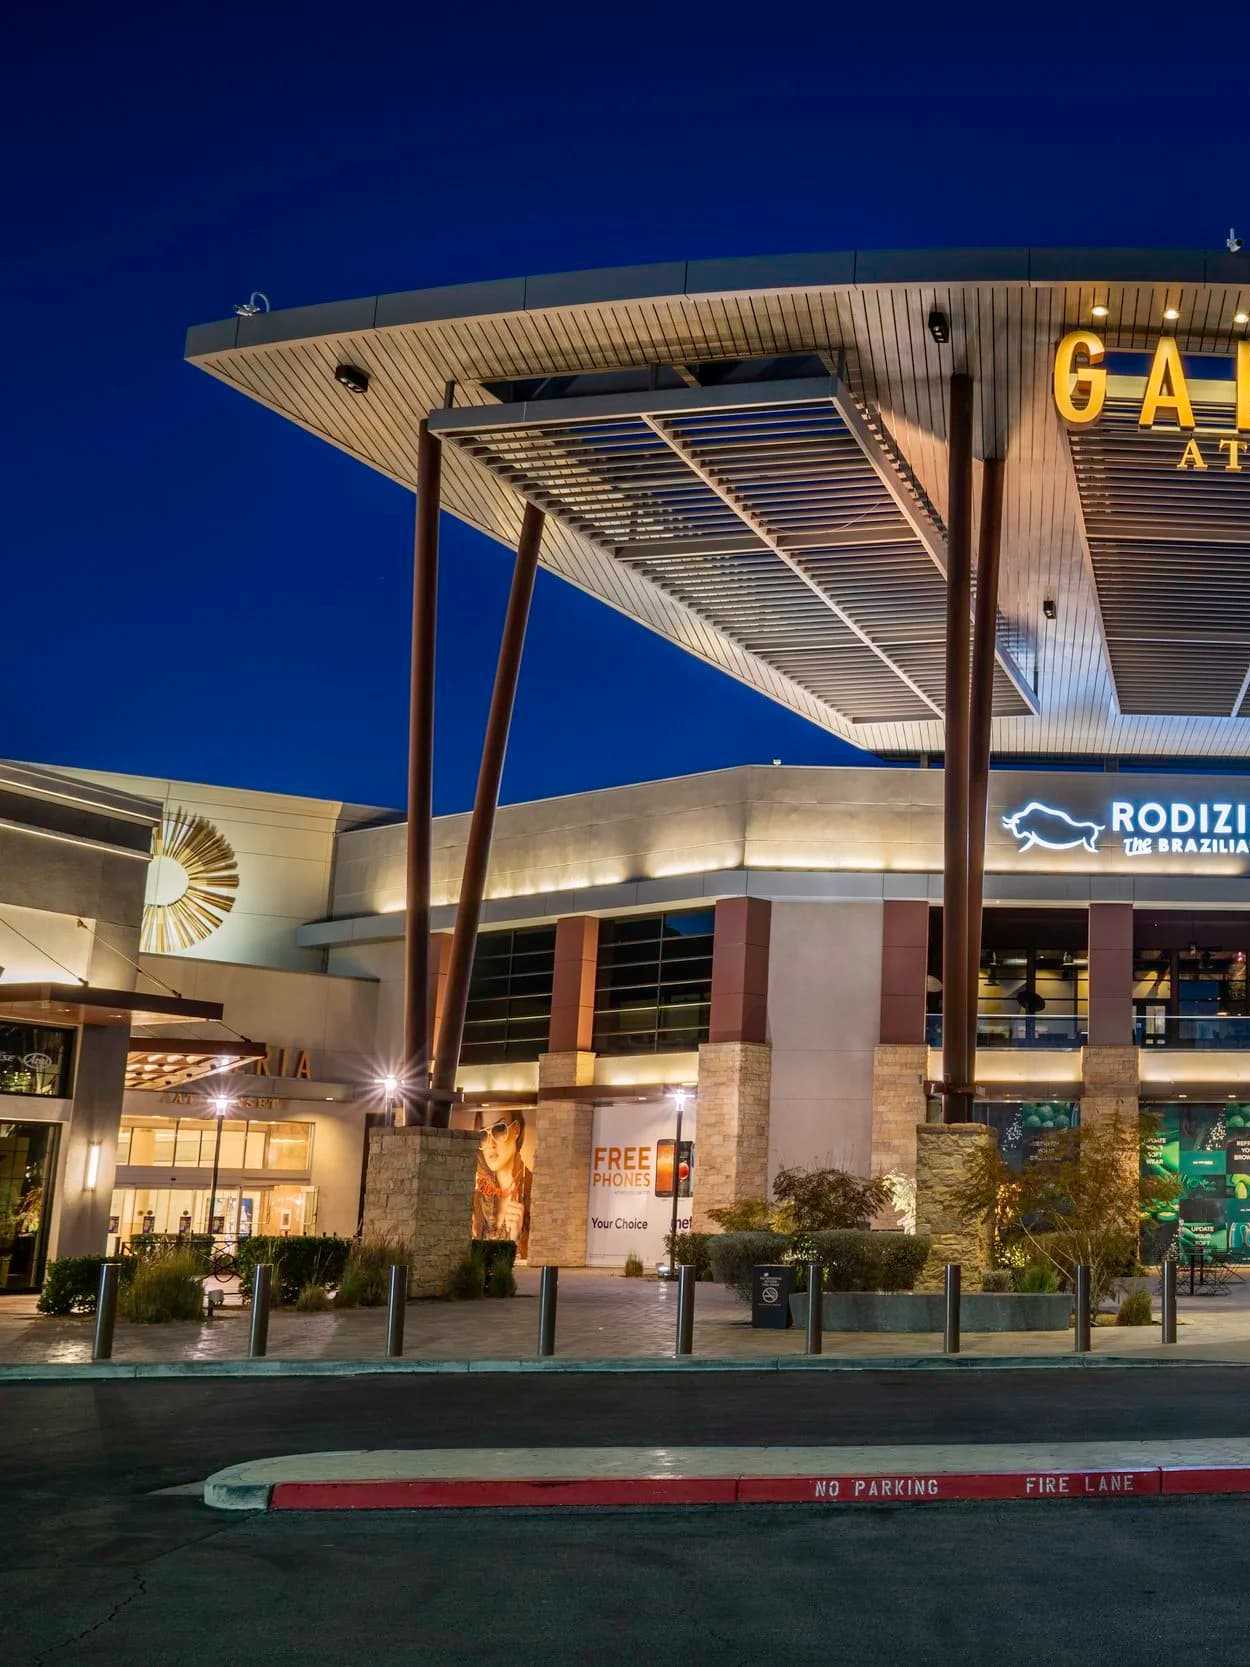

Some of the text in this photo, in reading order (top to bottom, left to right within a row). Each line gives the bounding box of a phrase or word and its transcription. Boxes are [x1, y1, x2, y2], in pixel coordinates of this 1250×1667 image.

[1177, 438, 1248, 472] AT
[594, 1147, 651, 1170] FREE
[592, 1173, 651, 1188] PHONES
[592, 1217, 613, 1229] Your
[615, 1217, 648, 1230] Choice
[815, 1475, 1134, 1498] NO PARKING FIRE LANE
